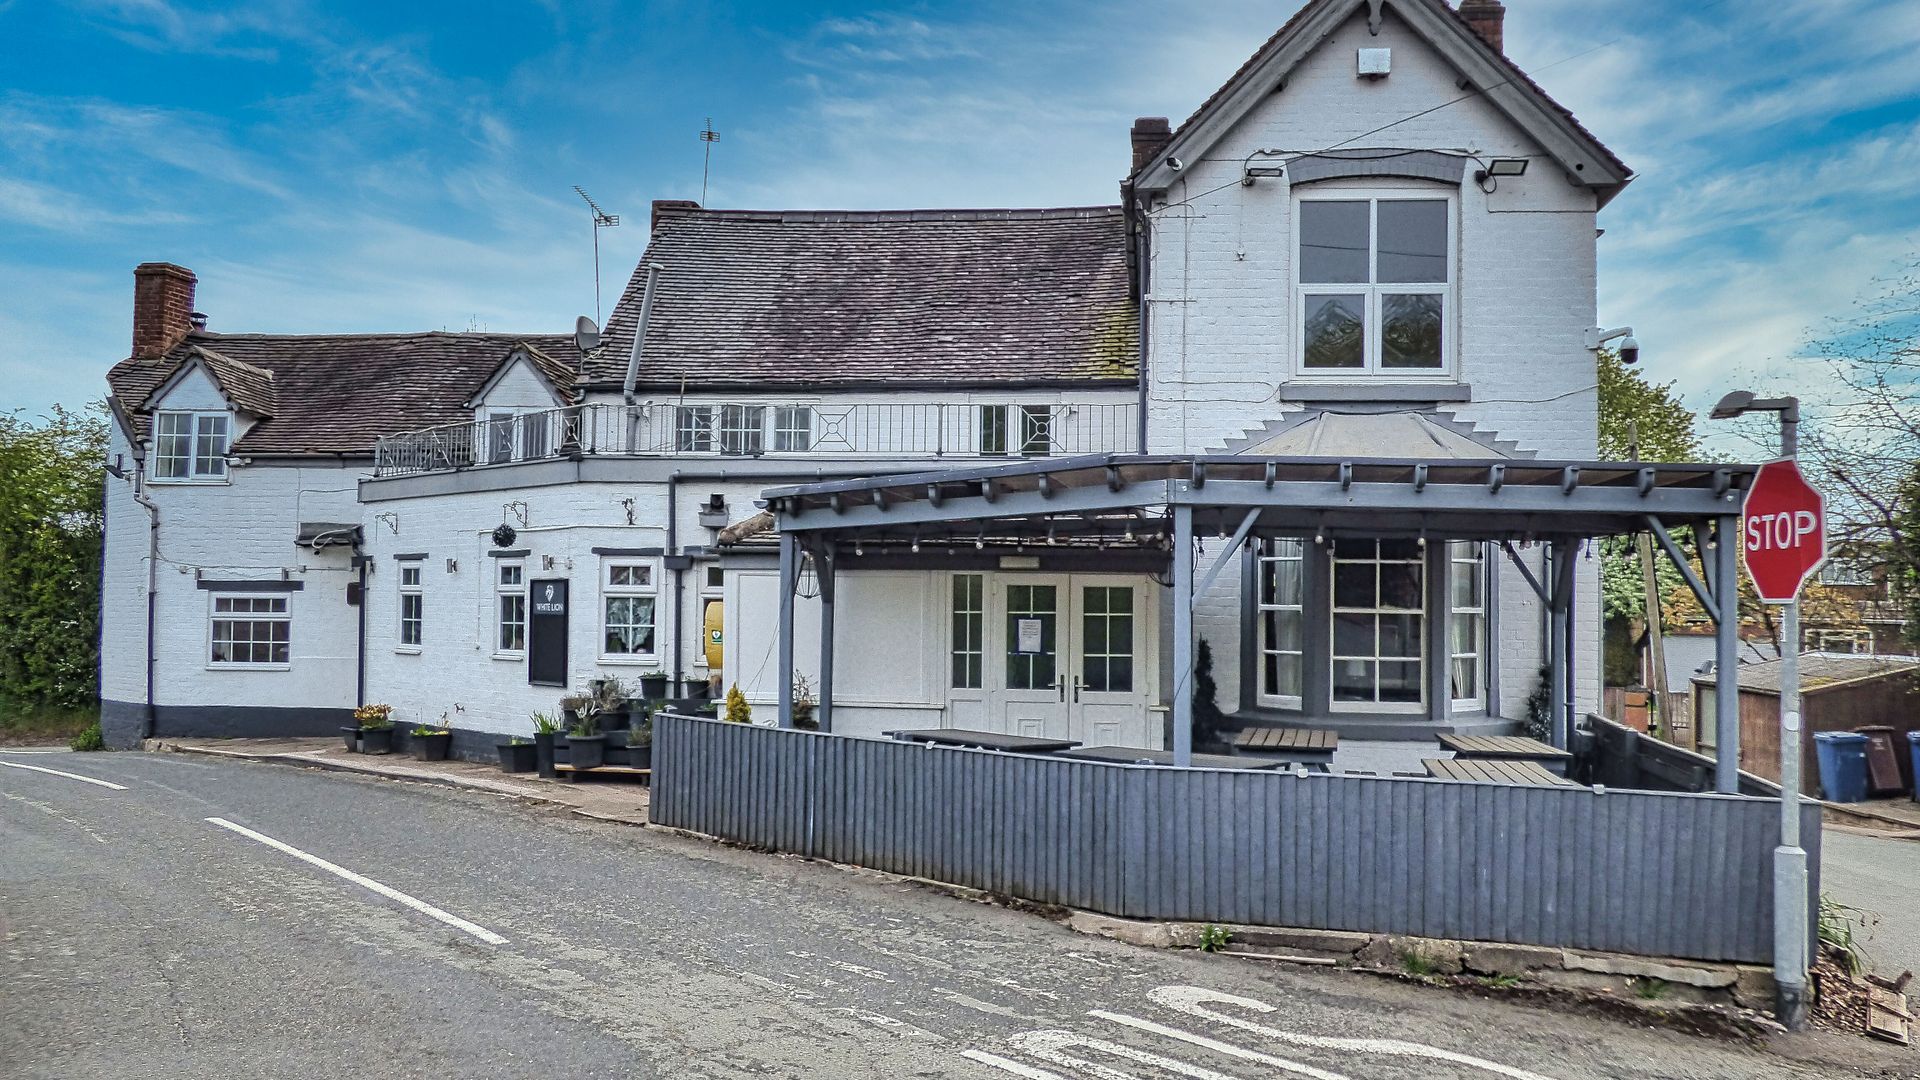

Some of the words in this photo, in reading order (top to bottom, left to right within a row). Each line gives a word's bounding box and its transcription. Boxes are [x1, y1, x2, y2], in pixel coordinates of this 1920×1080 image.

[1747, 510, 1817, 551] STOP
[536, 603, 551, 611] WHITE
[551, 603, 564, 611] LION
